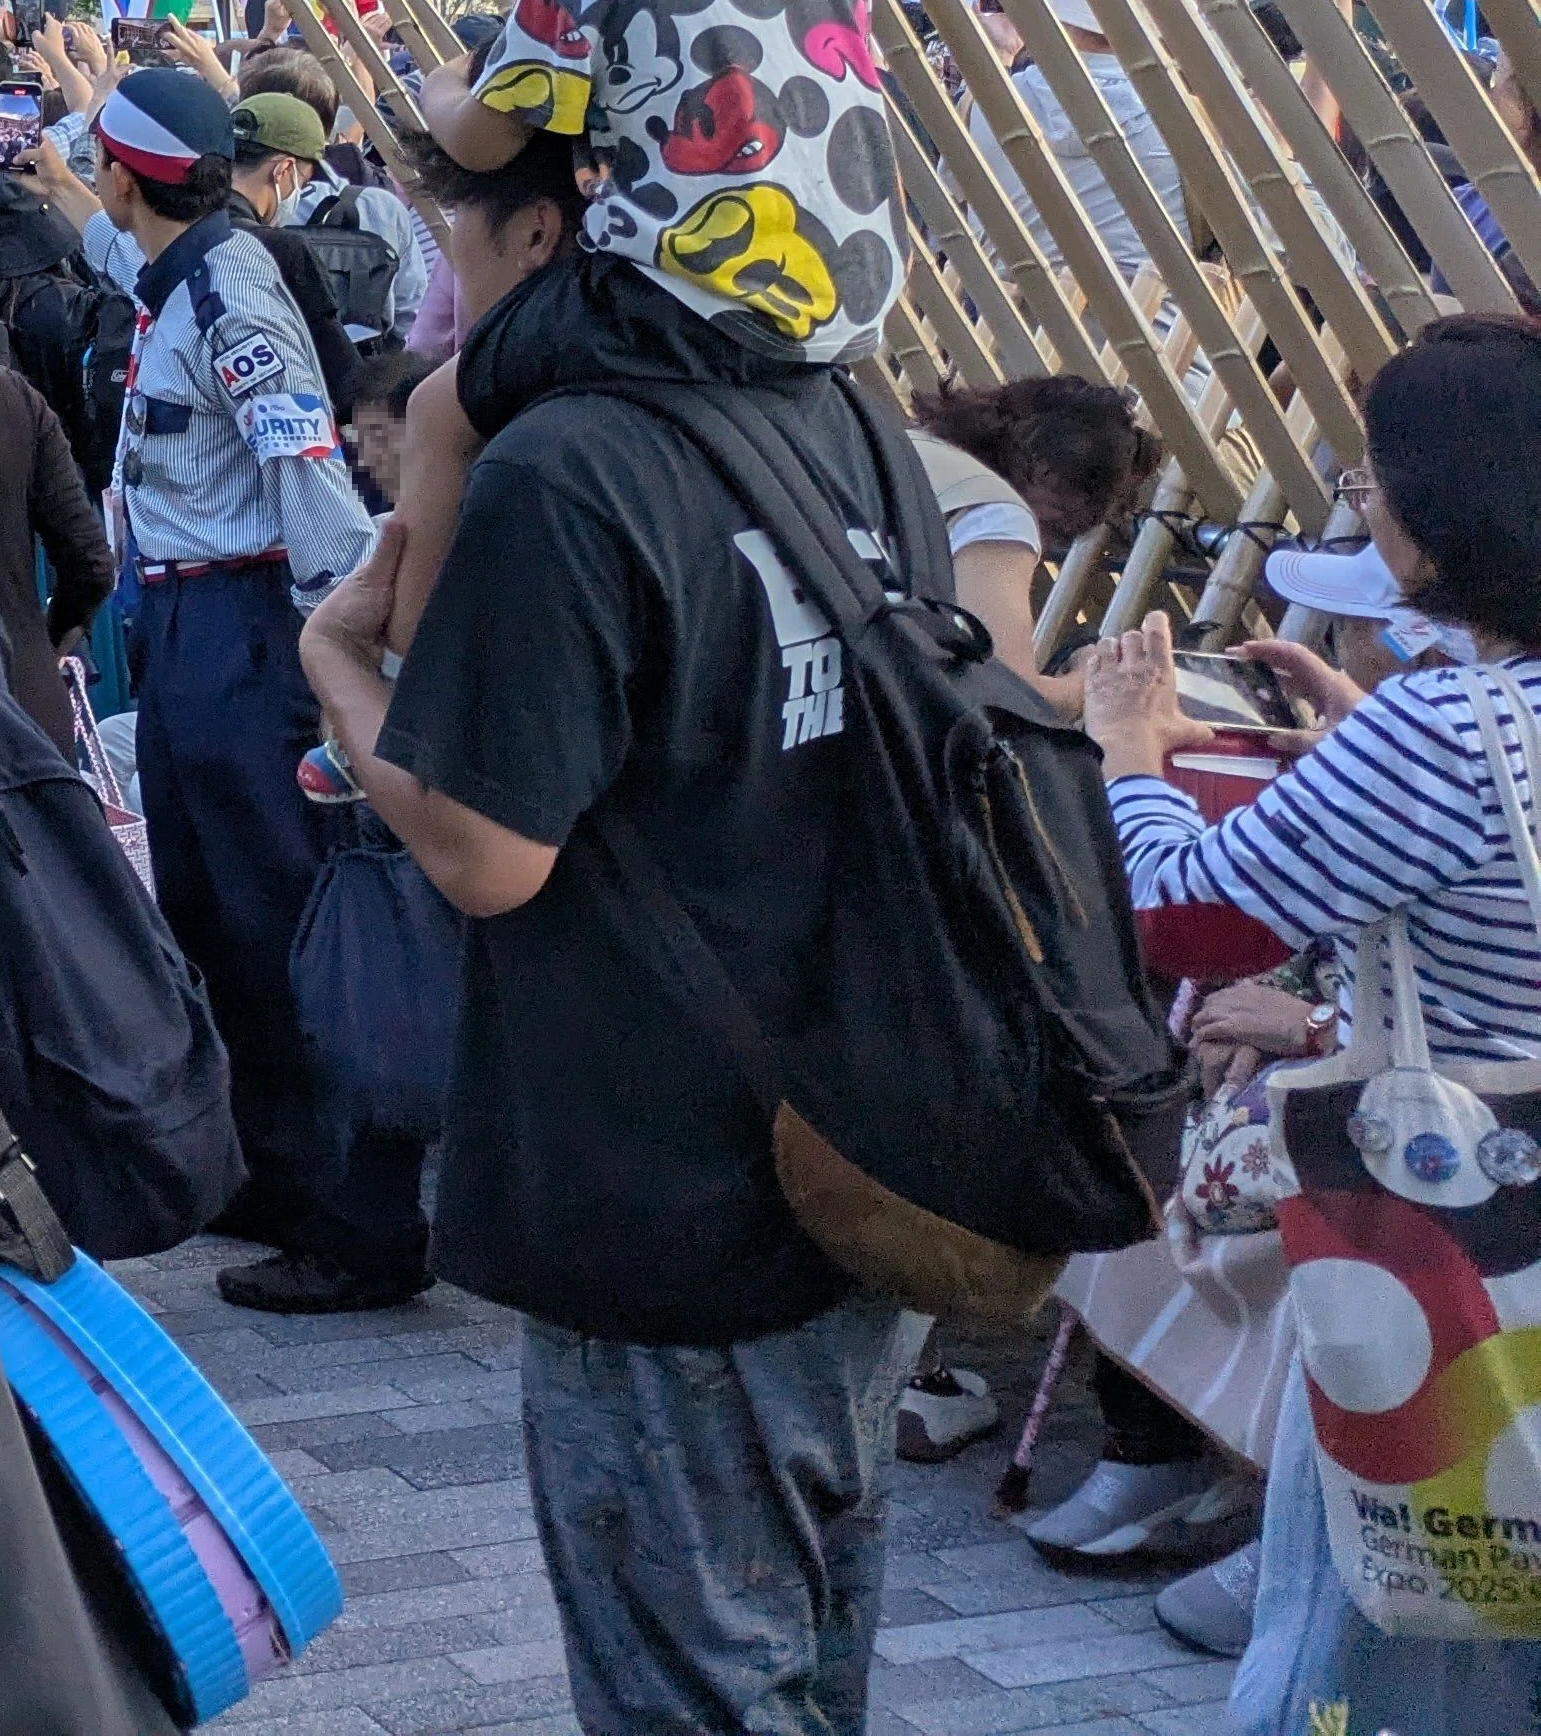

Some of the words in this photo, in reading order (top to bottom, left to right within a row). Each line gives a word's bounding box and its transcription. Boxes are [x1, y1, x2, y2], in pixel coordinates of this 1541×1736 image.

[222, 344, 275, 387] AOS
[782, 637, 842, 700] TO
[782, 687, 844, 751] THE
[1362, 1554, 1428, 1595] Expo
